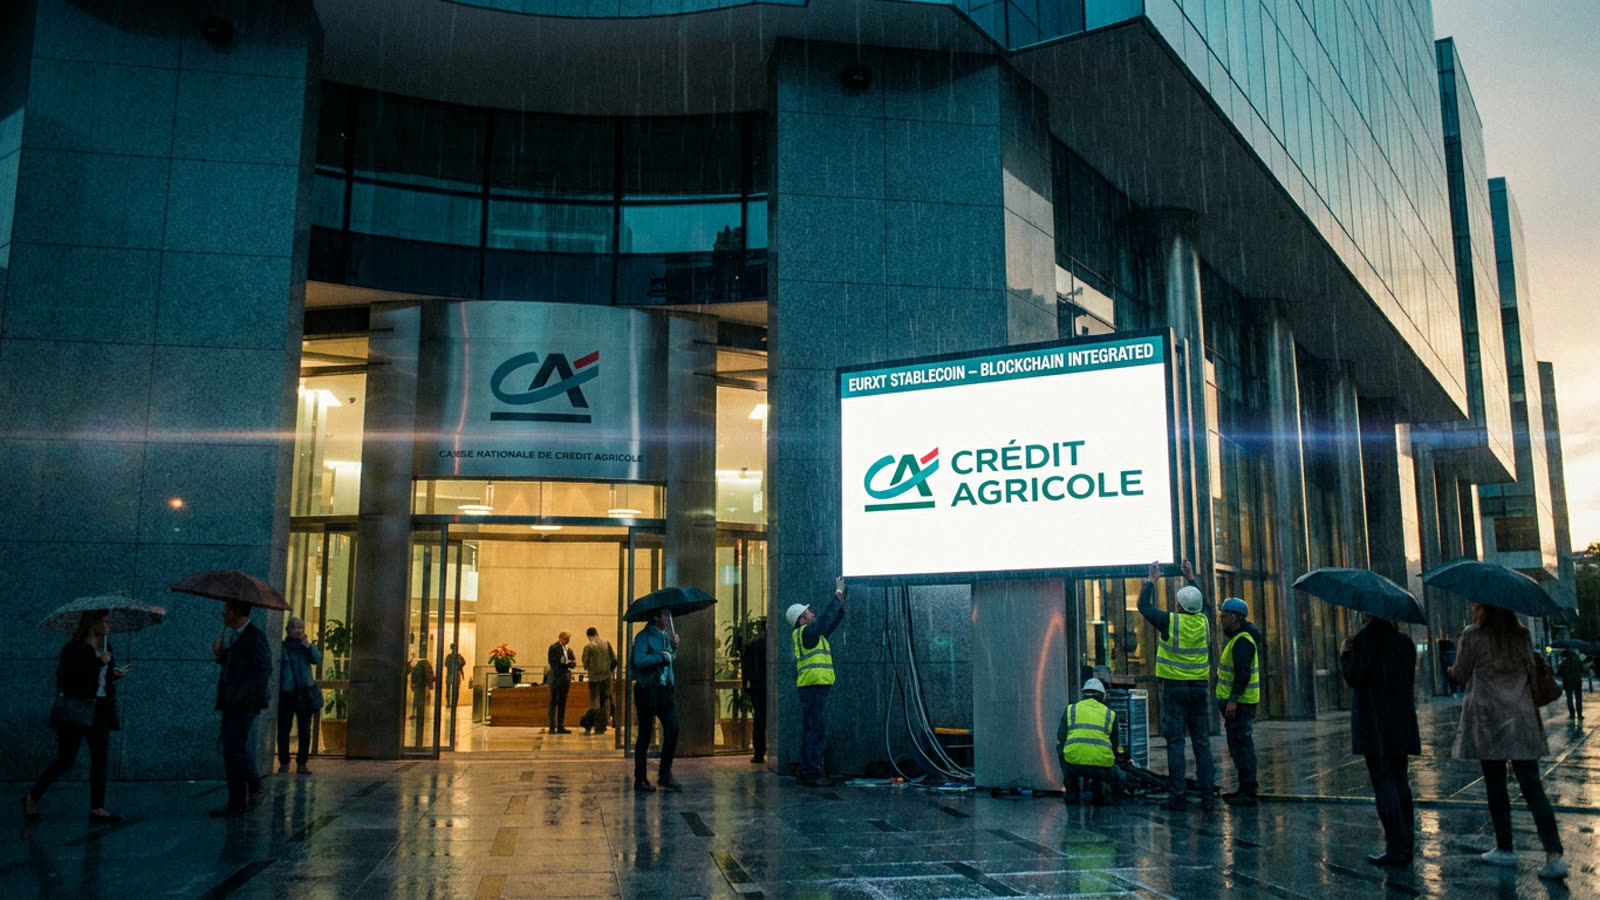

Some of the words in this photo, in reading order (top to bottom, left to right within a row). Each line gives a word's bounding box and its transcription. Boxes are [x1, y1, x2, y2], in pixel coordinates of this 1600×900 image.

[848, 374, 887, 392] EURXT
[890, 365, 965, 387] STABLECOIN
[980, 353, 1064, 377] BLOCKCHAIN
[1068, 343, 1154, 367] INTEGRATED
[538, 451, 553, 459] DE
[594, 453, 644, 463] AGRICOLE
[951, 439, 1085, 475] CRÉDIT
[951, 469, 1144, 507] AGRICOLE
